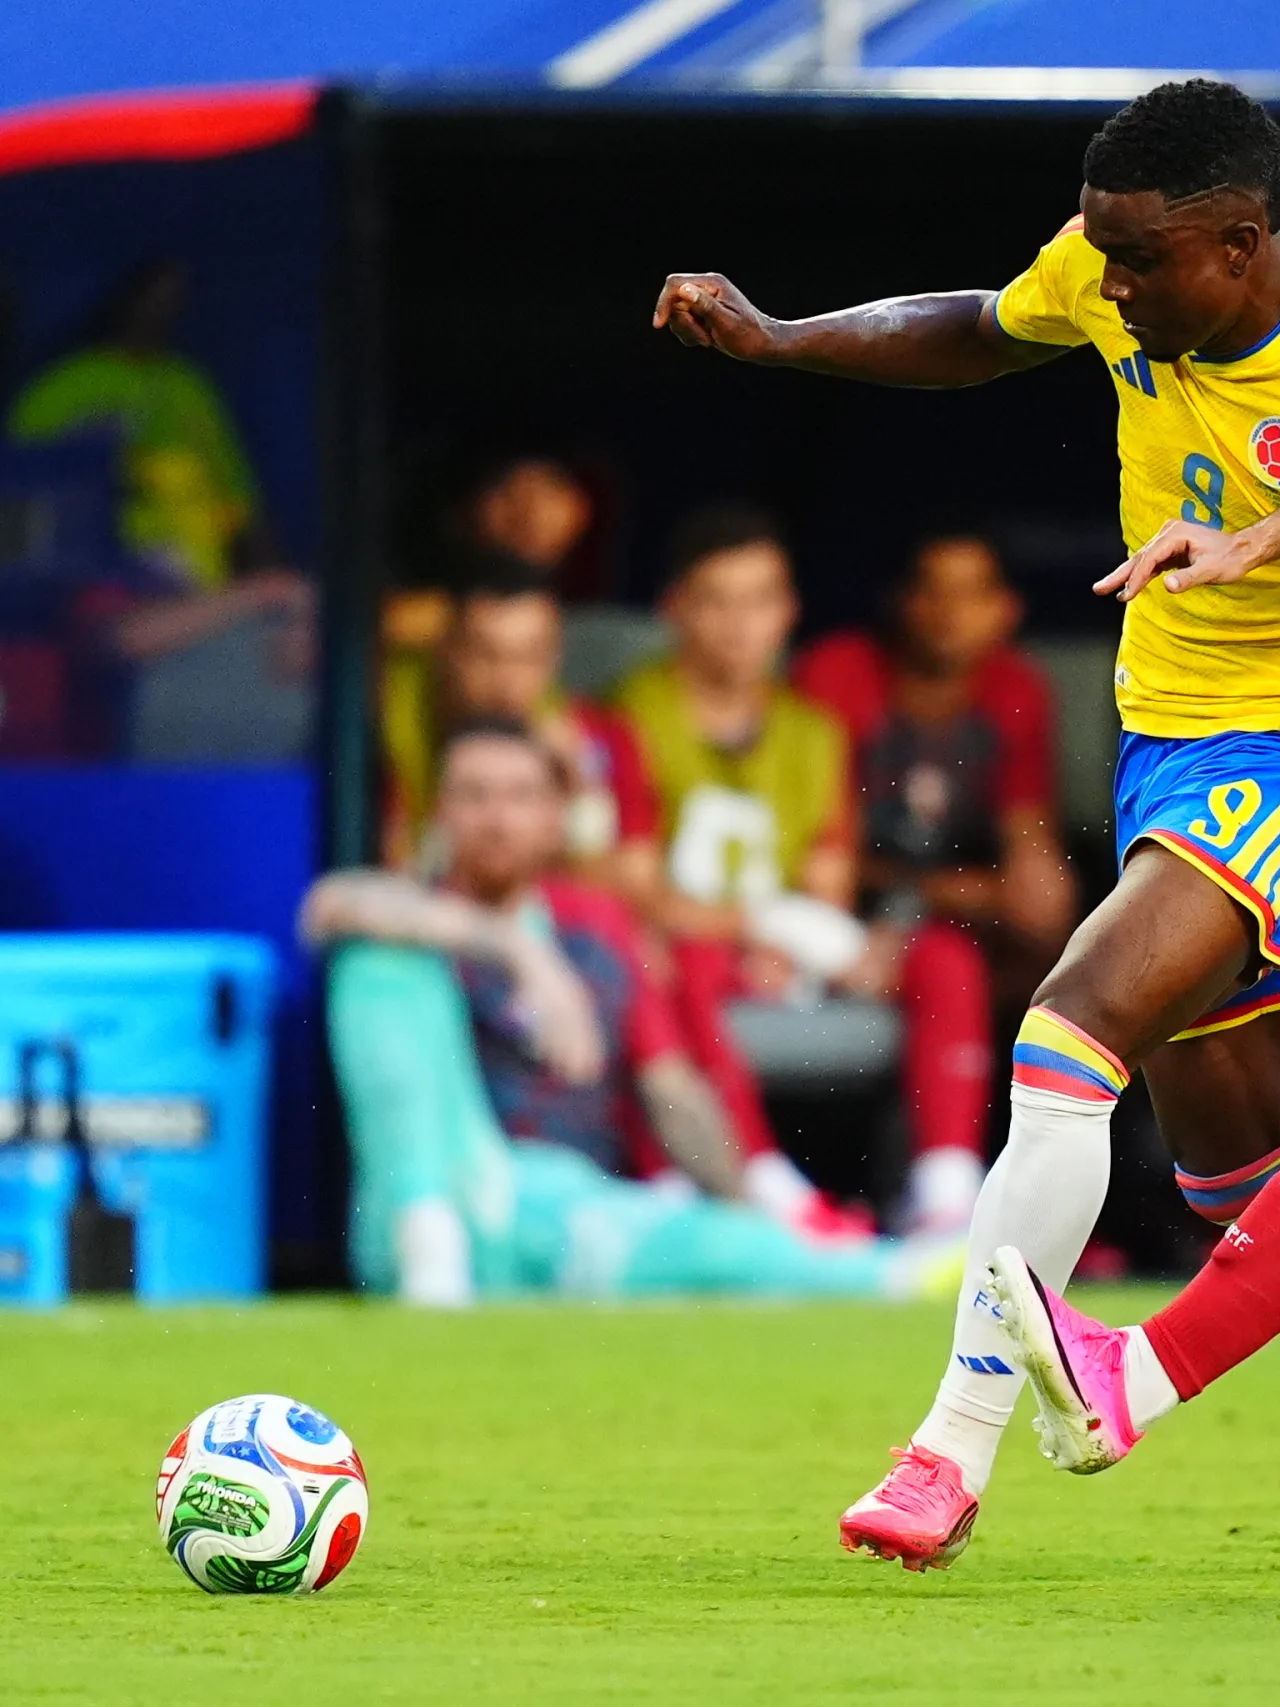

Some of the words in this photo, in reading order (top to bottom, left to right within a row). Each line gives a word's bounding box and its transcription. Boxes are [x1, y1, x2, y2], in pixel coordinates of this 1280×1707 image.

[1181, 452, 1225, 531] 9
[1188, 778, 1262, 849] 9
[196, 1480, 256, 1508] TRIONDA
